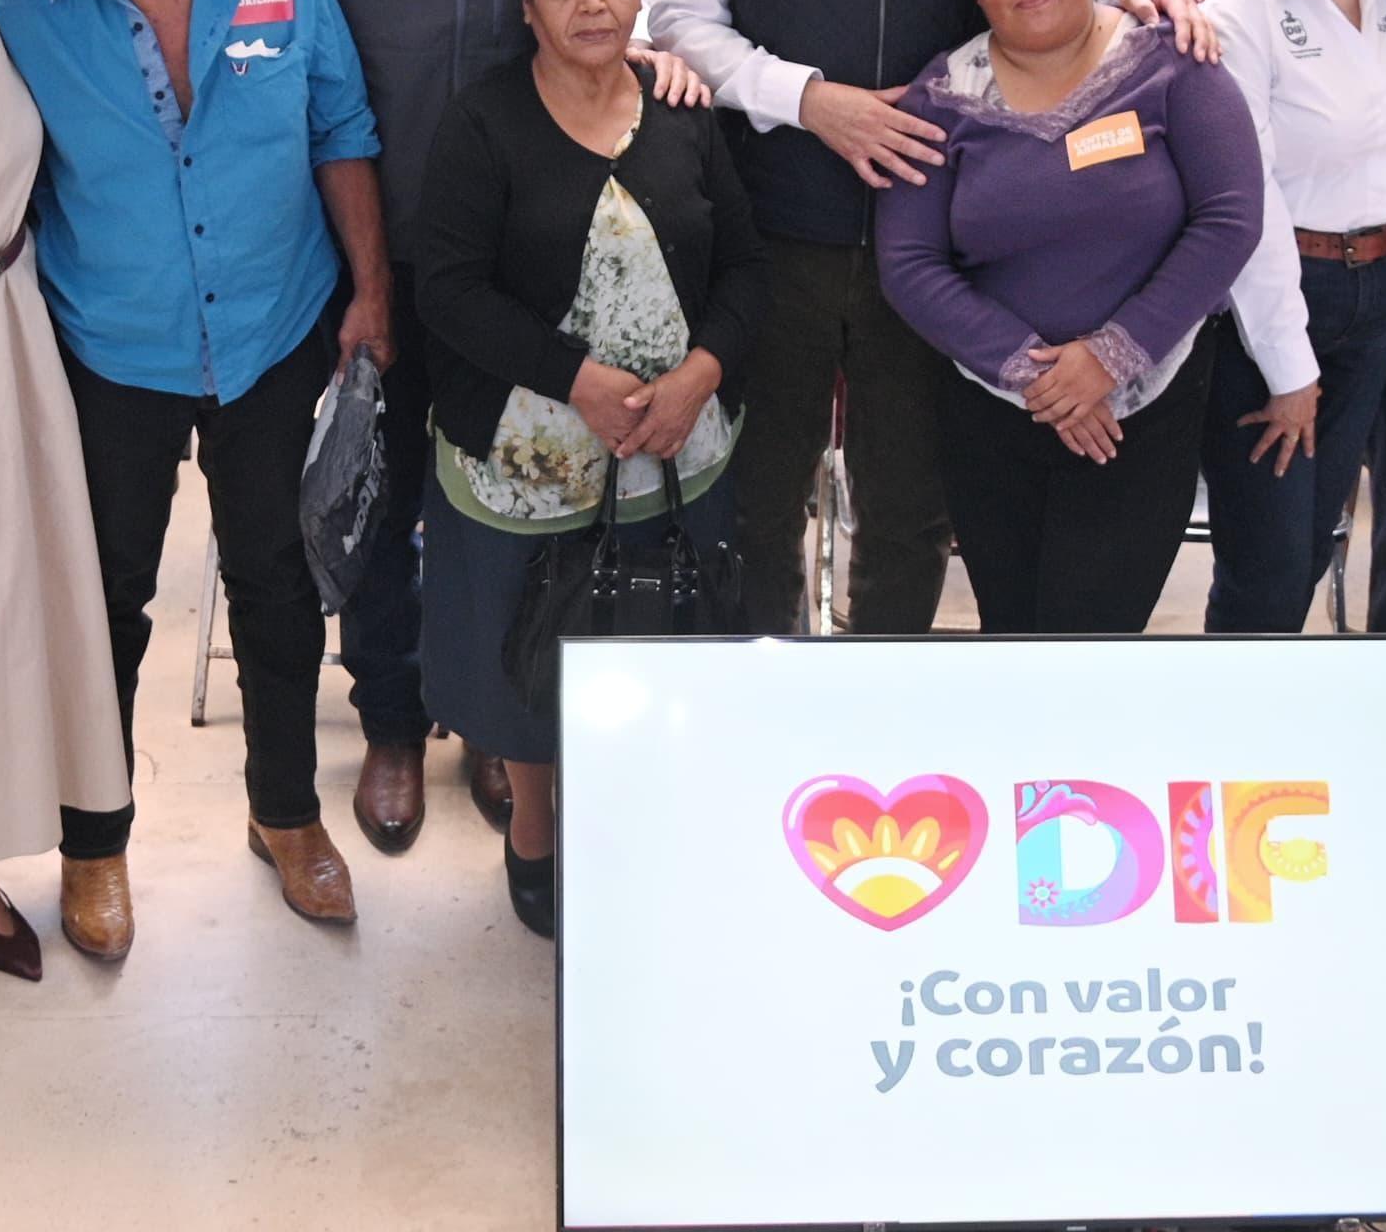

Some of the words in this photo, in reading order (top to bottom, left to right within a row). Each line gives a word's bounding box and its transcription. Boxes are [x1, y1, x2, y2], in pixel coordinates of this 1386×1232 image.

[1014, 779, 1330, 927] DIF
[899, 970, 1048, 1027] ¡Con
[1064, 968, 1237, 1014] valor
[870, 1040, 916, 1094] y
[935, 1015, 1266, 1078] corazón!
